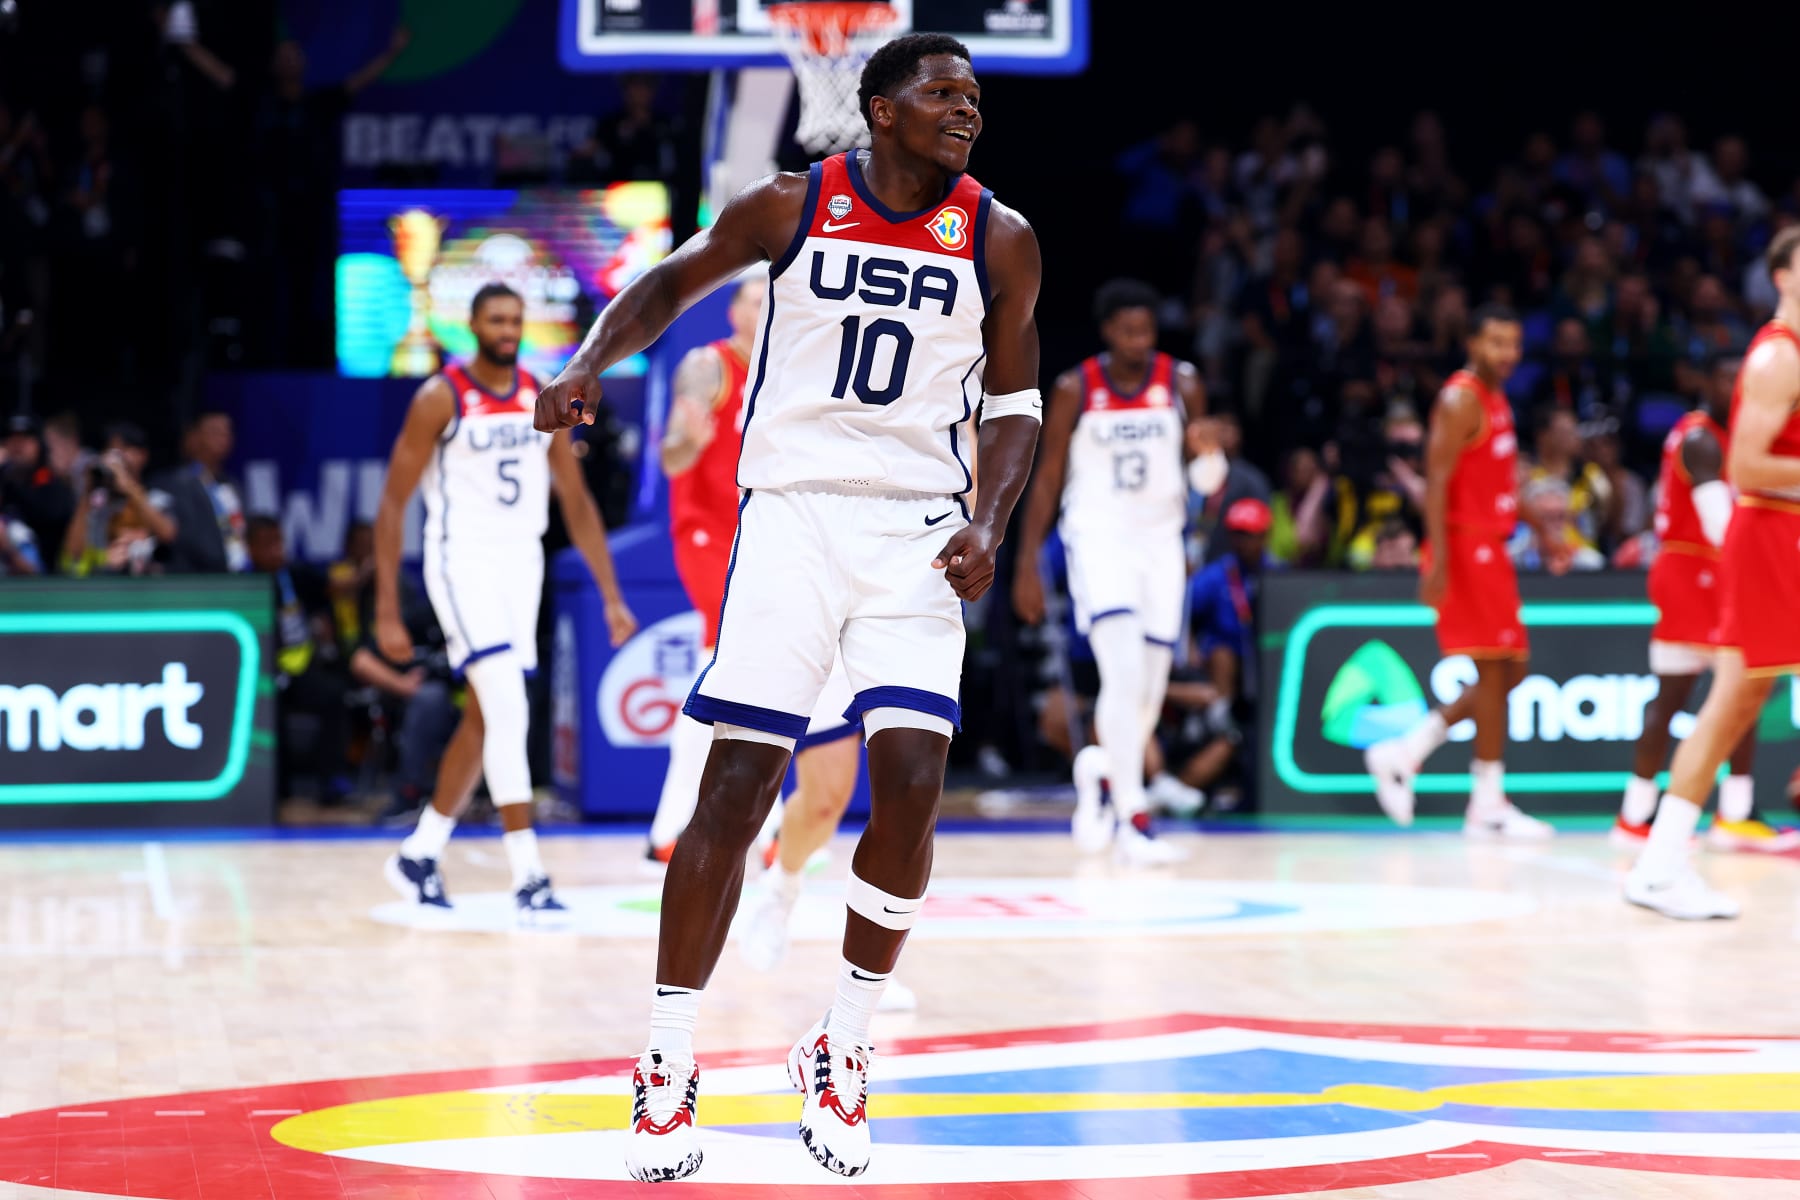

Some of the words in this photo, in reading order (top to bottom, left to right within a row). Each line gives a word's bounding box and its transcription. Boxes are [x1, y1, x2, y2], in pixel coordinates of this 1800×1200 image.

[810, 251, 958, 316] USA
[831, 315, 914, 406] 10
[468, 423, 542, 452] USA
[1090, 419, 1165, 447] USA
[497, 458, 521, 506] 5
[1113, 450, 1148, 493] 13
[246, 465, 424, 561] WI
[1430, 654, 1697, 741] Smar
